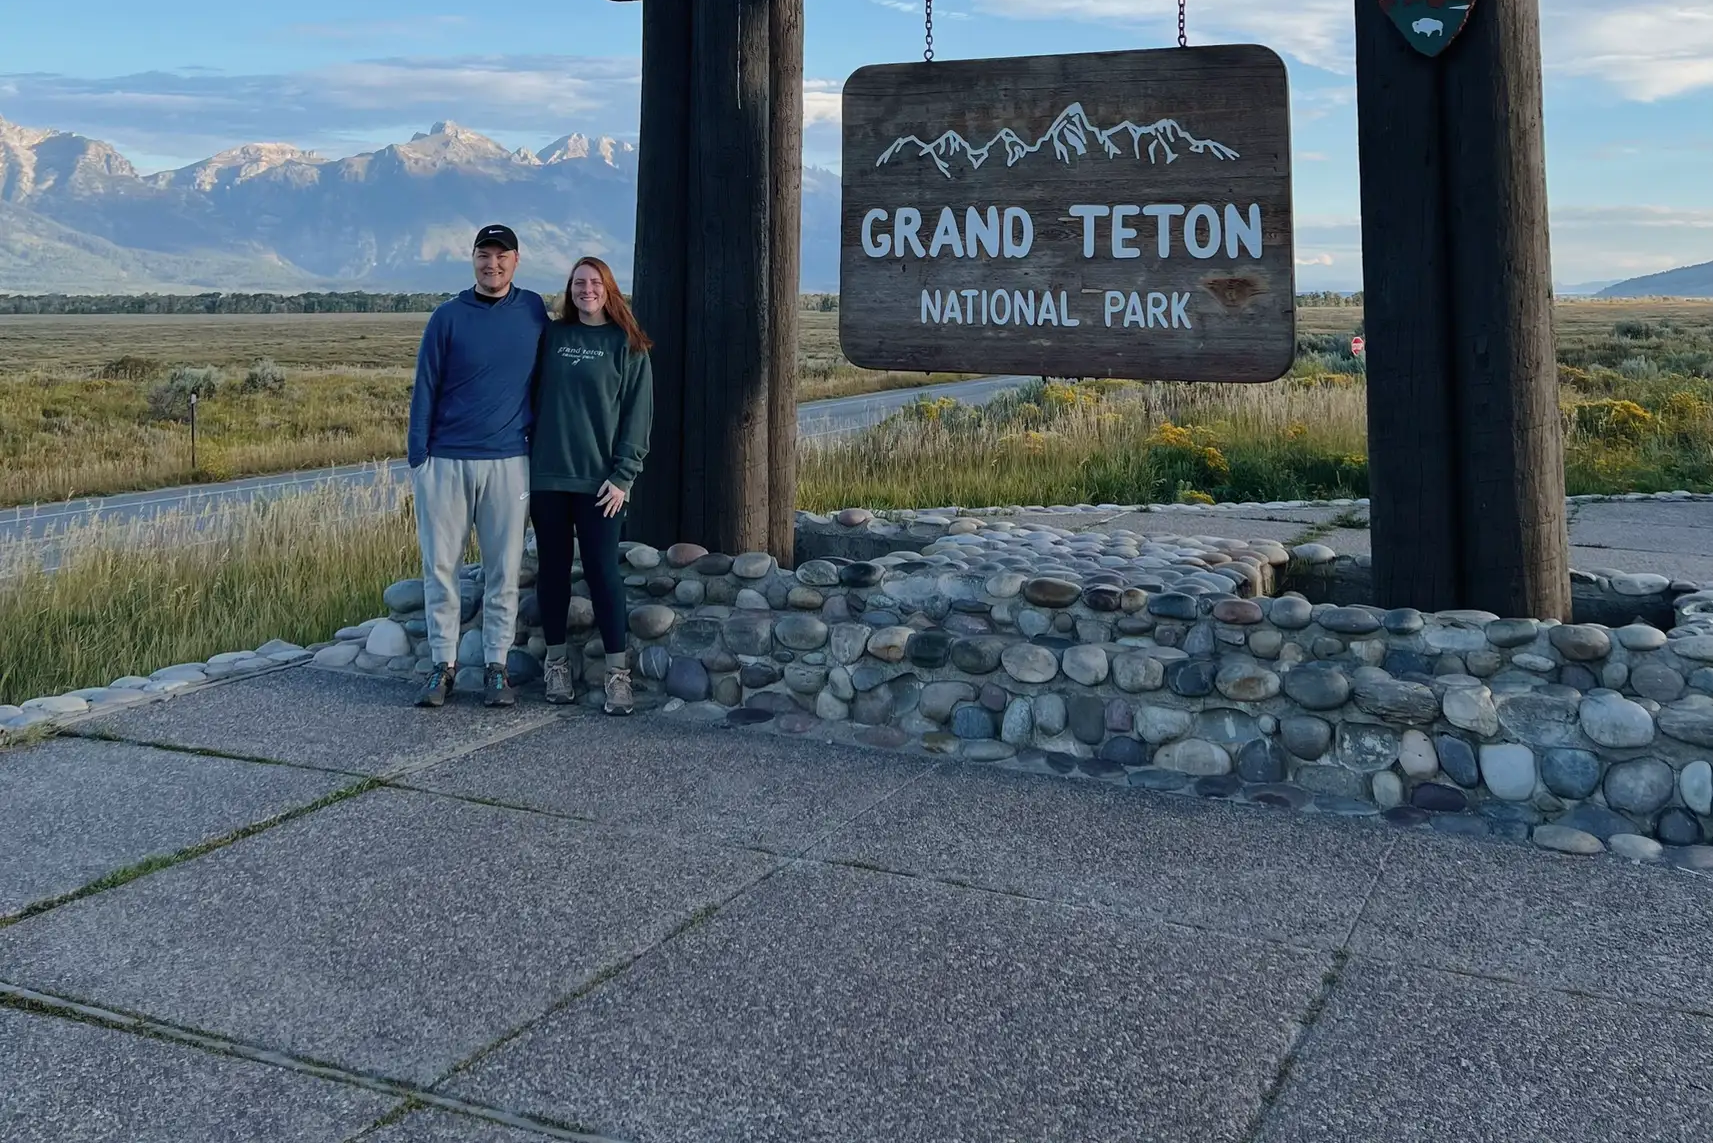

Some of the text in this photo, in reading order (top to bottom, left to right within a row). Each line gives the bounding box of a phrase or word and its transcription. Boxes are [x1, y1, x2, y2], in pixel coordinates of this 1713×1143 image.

[861, 203, 1263, 259] GRAND TETON
[920, 288, 1193, 330] NATIONAL PARK
